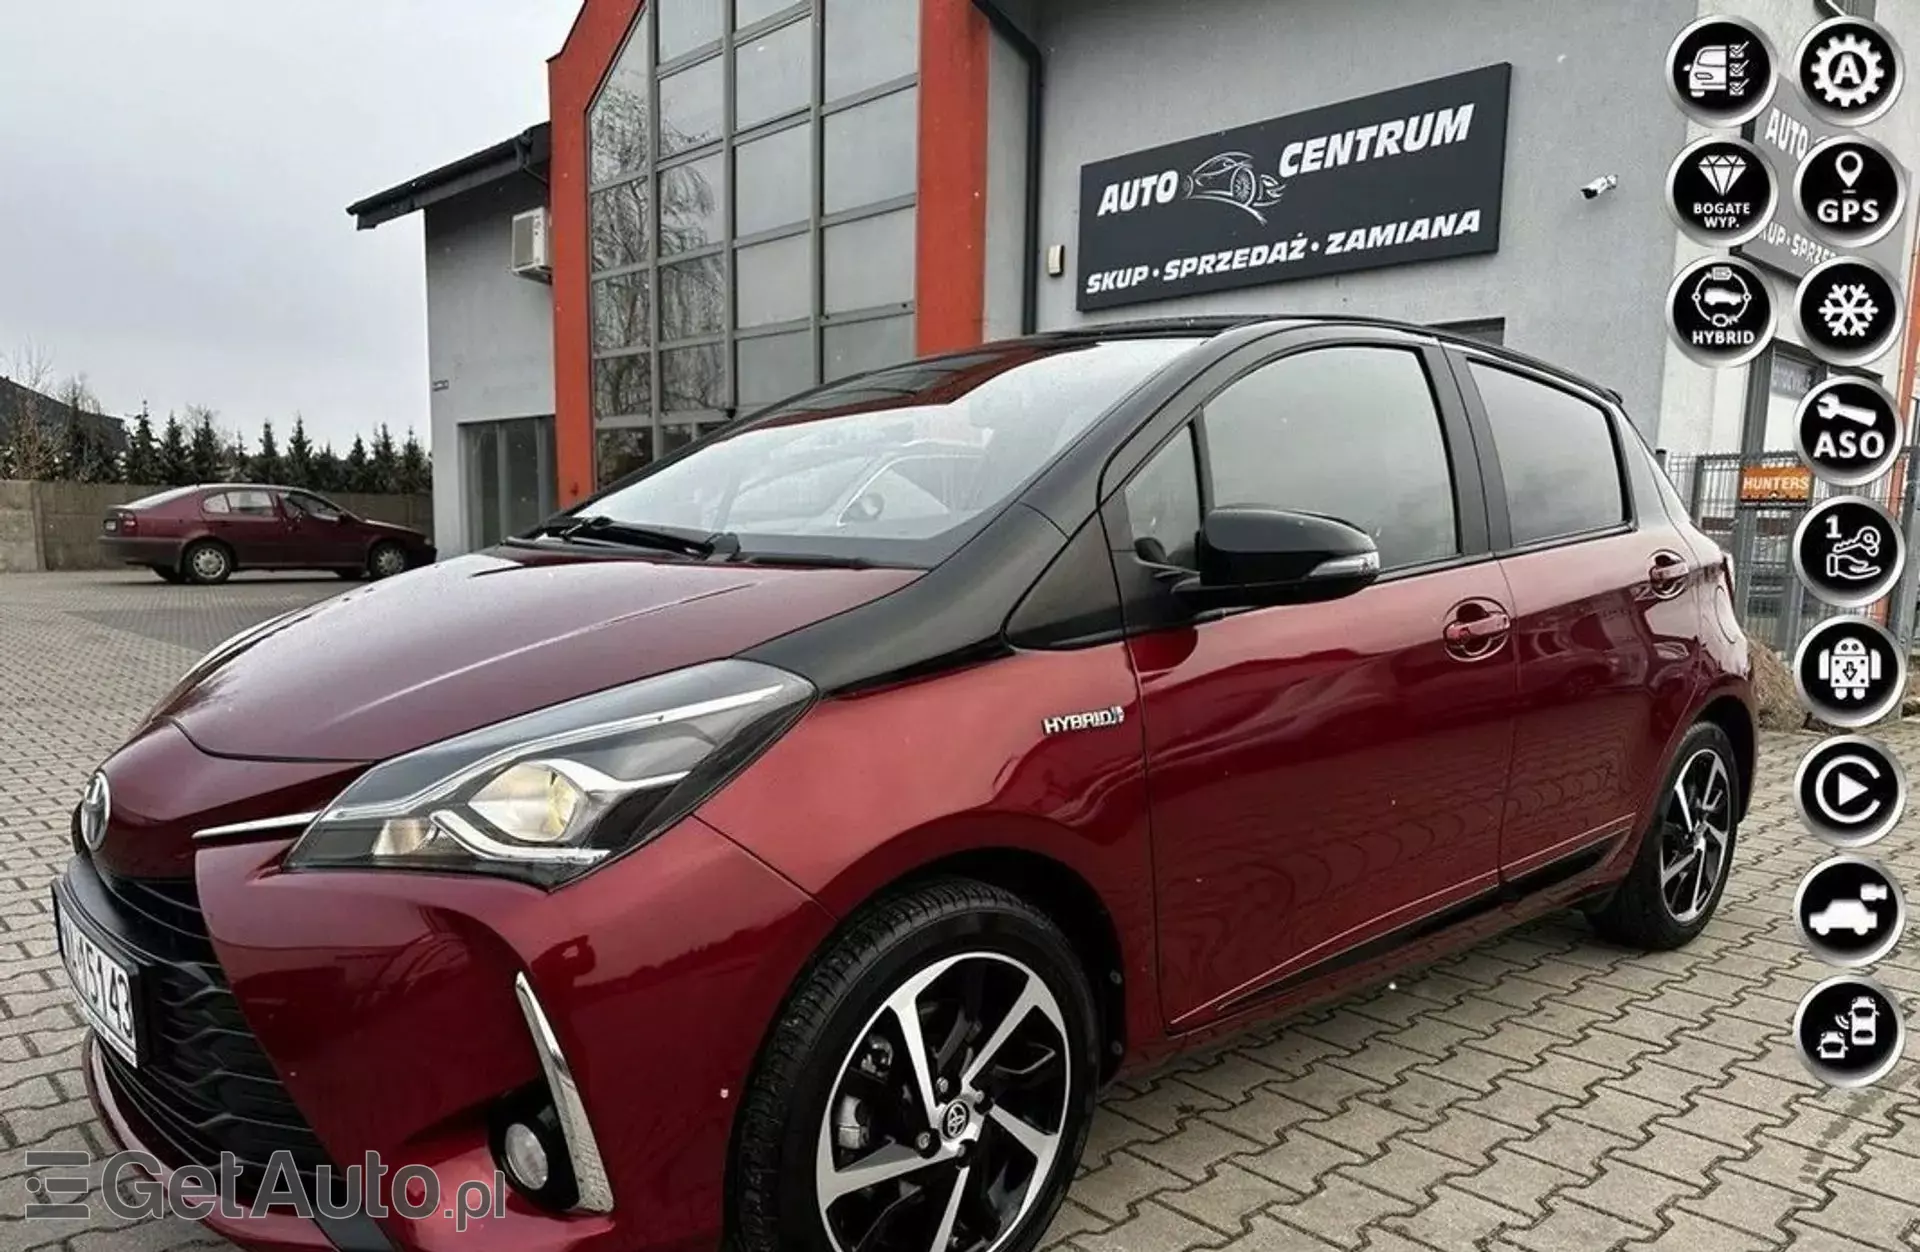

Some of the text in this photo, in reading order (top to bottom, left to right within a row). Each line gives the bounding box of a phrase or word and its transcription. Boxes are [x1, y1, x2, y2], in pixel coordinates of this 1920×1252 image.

[1098, 104, 1475, 216] AUTO CENTRUM
[1765, 107, 1810, 162] AUTO
[1086, 210, 1481, 295] SKUP SPRZEDAŻ ZAMIANA
[1743, 476, 1809, 490] HUNTERS
[1043, 709, 1115, 734] HYBRID
